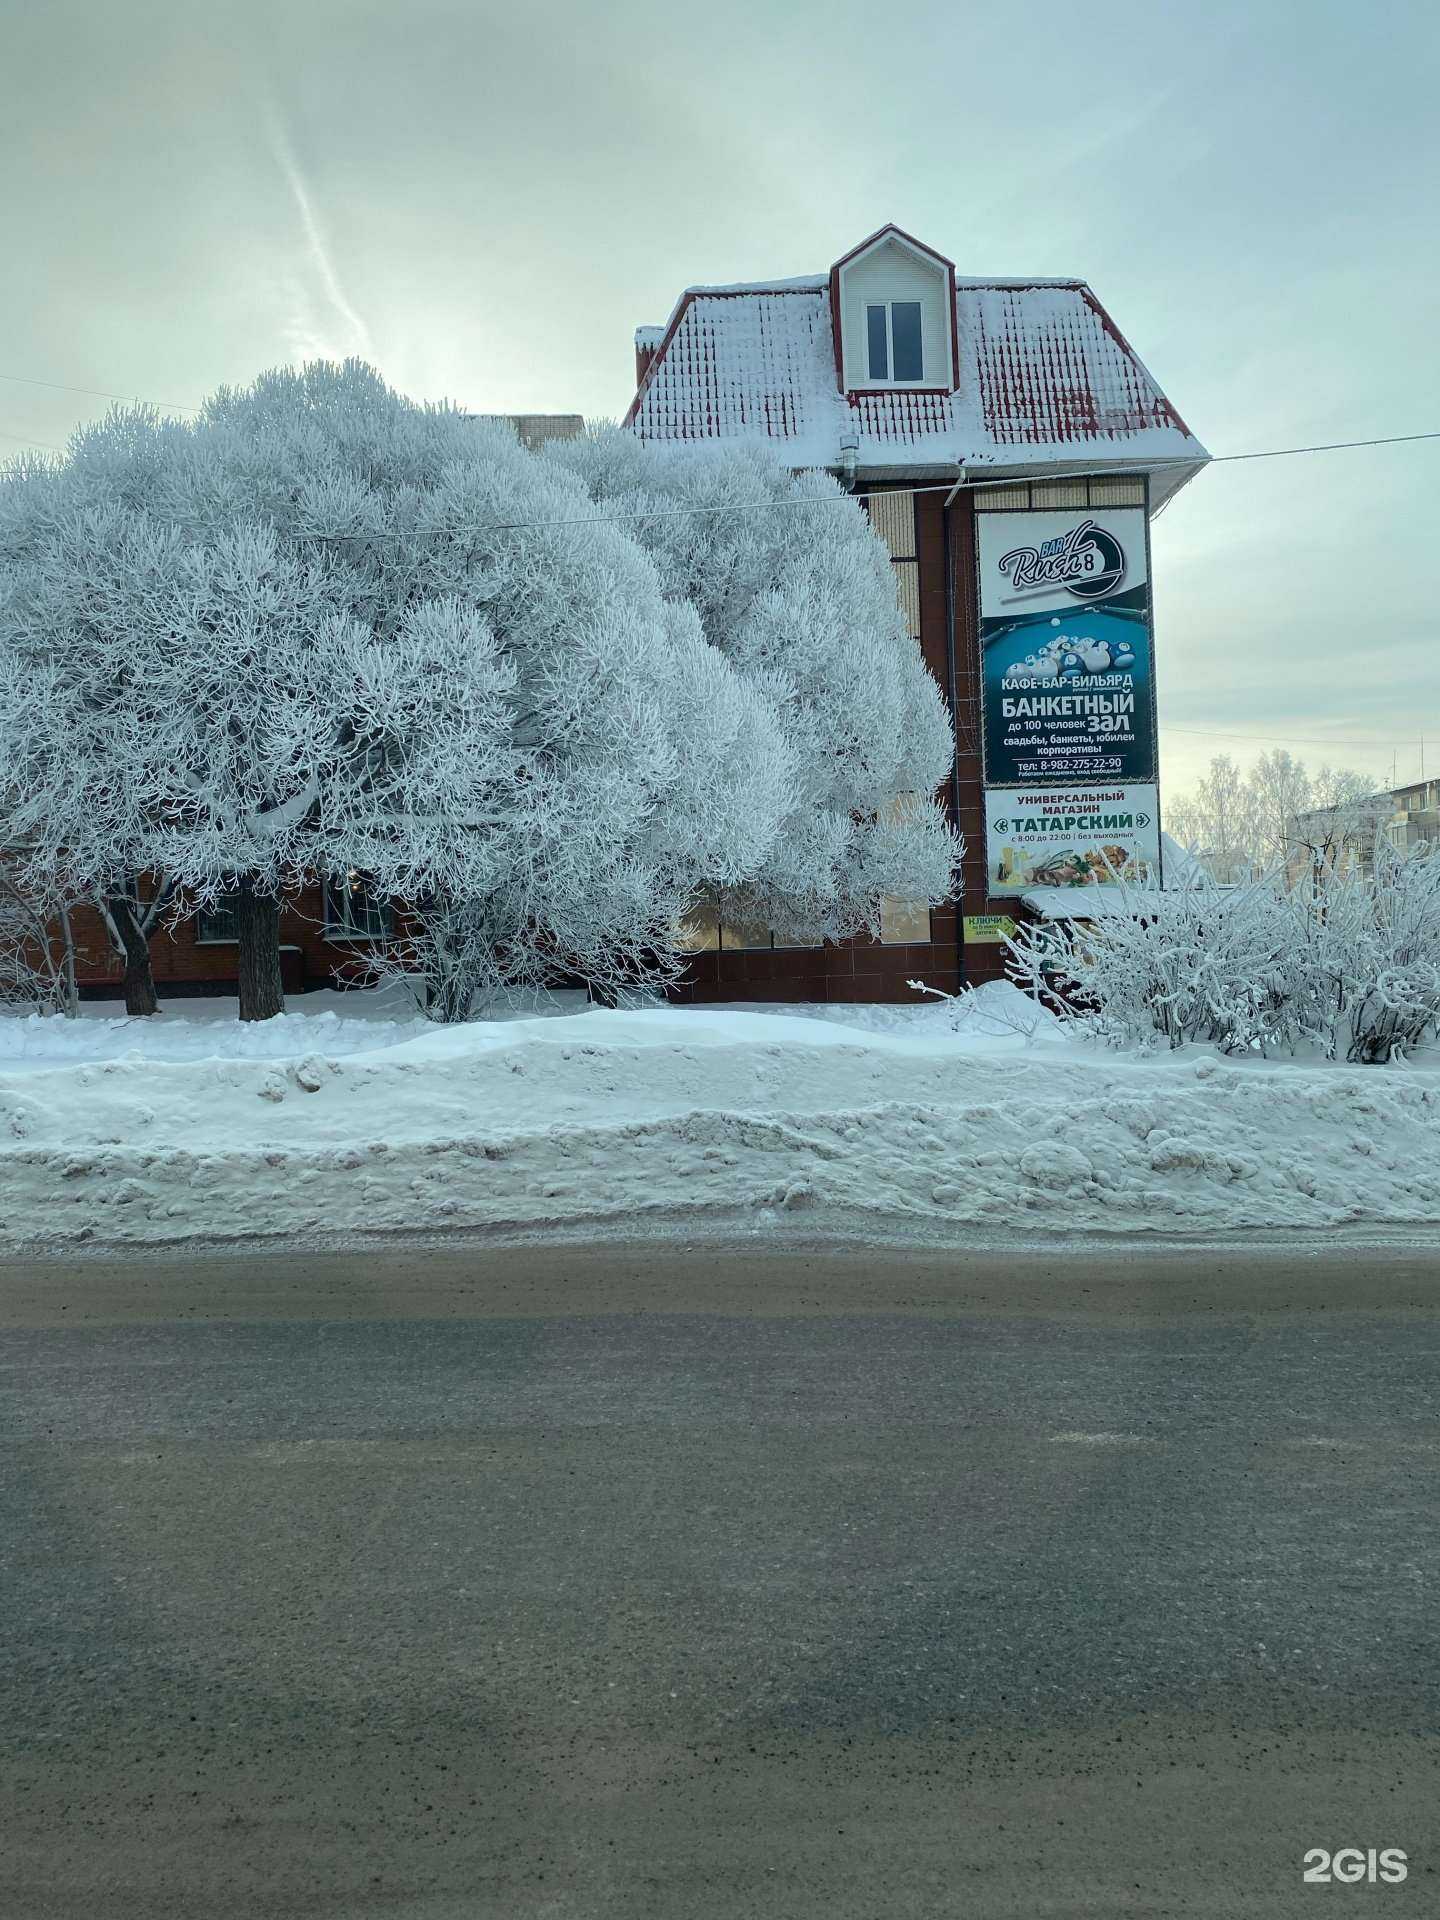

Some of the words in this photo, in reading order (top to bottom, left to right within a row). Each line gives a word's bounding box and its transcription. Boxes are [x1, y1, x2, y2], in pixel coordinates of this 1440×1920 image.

[1040, 537, 1065, 559] BAR
[1084, 554, 1094, 571] 8
[1001, 674, 1133, 690] КАФЕ-БАР-БИЛЬЯРД
[1002, 688, 1135, 718] БАНКЕТНЫЙ
[1008, 722, 1021, 733] до
[1024, 720, 1041, 730] 100
[1044, 720, 1086, 730] человек
[1087, 714, 1130, 733] зал
[1003, 735, 1048, 746] свадьбы,
[1050, 735, 1094, 745] банкеты,
[1096, 732, 1135, 742] юбилеи
[1037, 745, 1102, 756] корпоративы
[1017, 763, 1038, 771] тел:
[1040, 758, 1121, 770] 8-982-275-22-90
[1017, 790, 1125, 805] УНИВЕРСАЛЬНЫЙ
[1042, 805, 1100, 815] МАГАЗИН
[1011, 812, 1133, 832] ТАТАРСКИЙ
[1078, 832, 1092, 840] без
[1093, 832, 1134, 840] выходных
